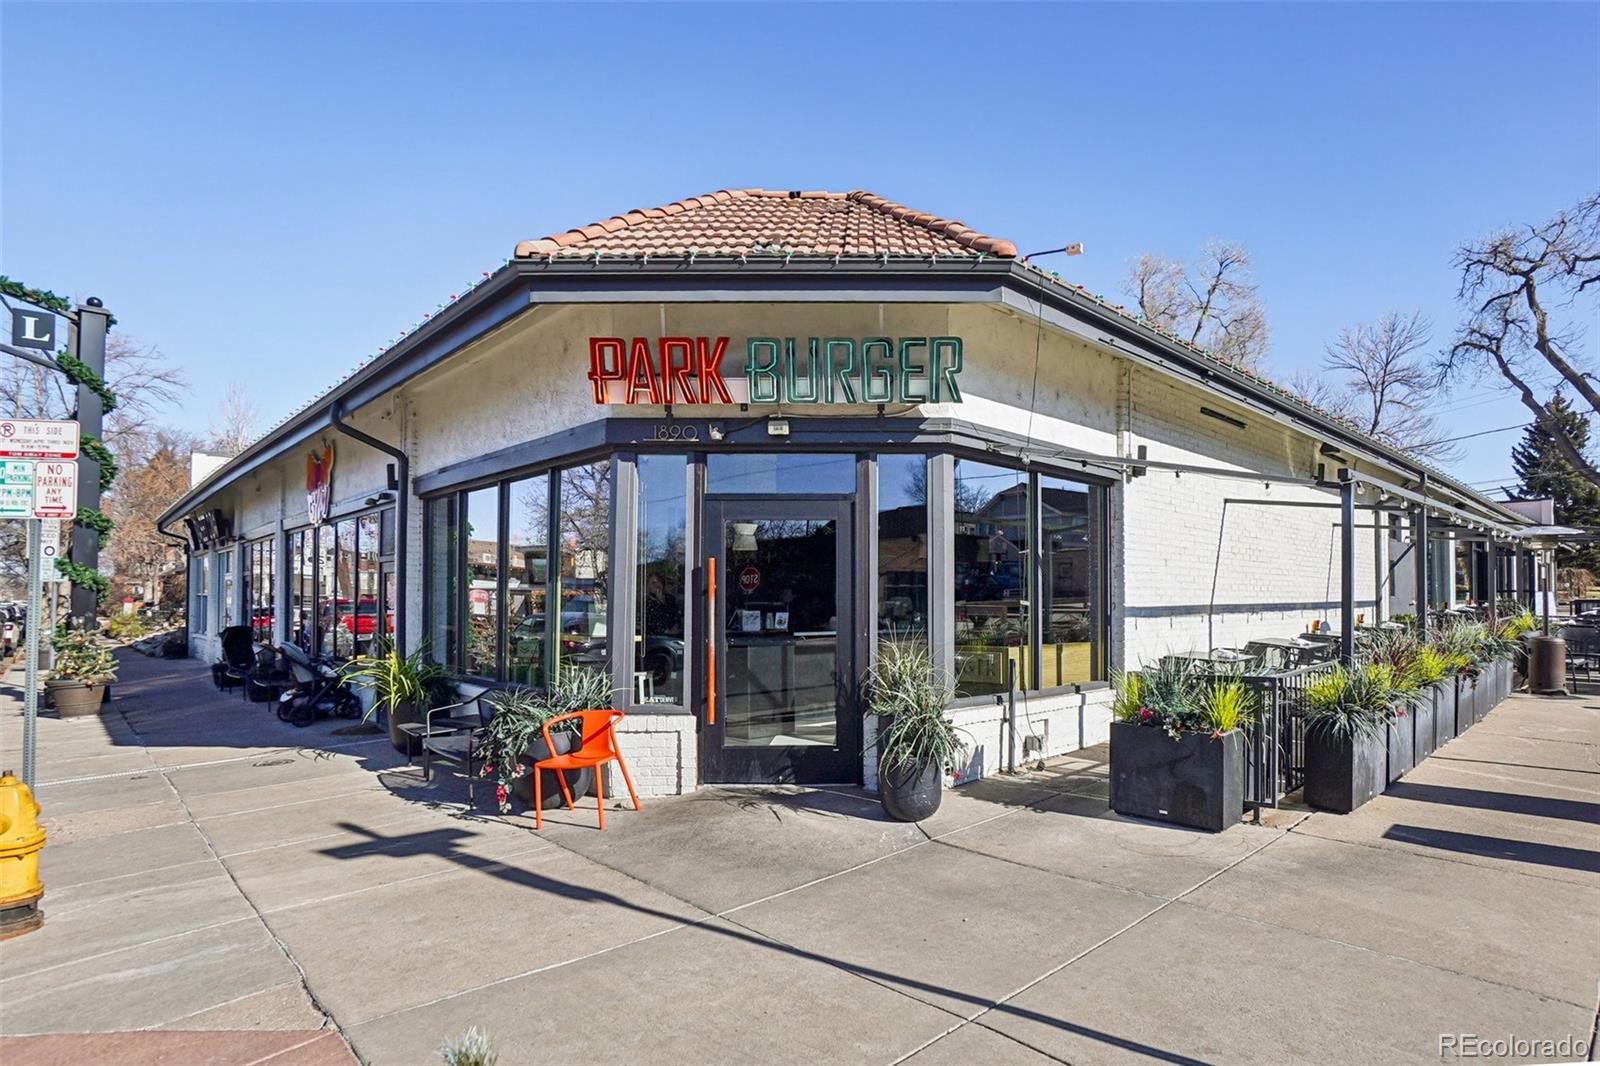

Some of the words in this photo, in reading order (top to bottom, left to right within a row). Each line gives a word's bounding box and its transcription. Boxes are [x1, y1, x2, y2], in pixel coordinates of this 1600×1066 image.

[22, 315, 50, 342] L
[587, 336, 733, 404] PARK
[744, 336, 964, 404] BURGER
[46, 427, 63, 435] SIDE
[653, 425, 698, 440] 1890
[47, 464, 63, 475] NO
[37, 476, 73, 487] PARKING
[45, 496, 63, 504] TIME
